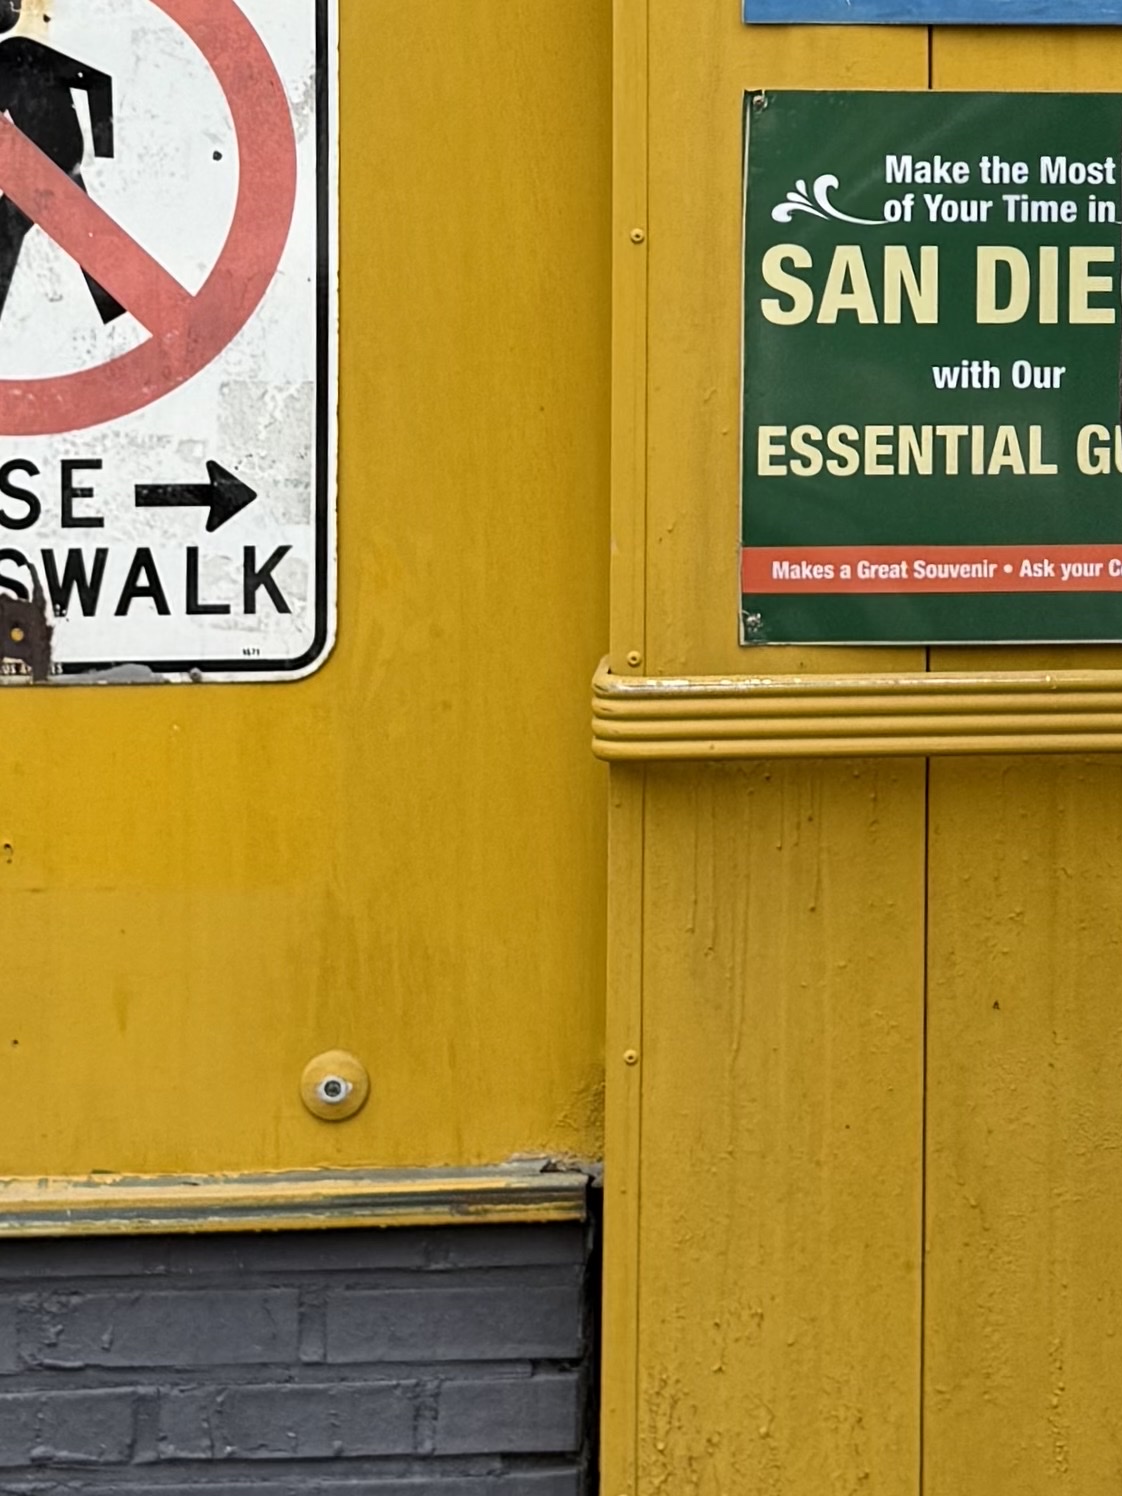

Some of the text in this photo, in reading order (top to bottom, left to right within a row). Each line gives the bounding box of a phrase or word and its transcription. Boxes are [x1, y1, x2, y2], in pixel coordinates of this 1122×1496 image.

[885, 155, 1116, 185] Make the Most
[883, 193, 1116, 223] of Your Time in
[761, 243, 1116, 326] SAN DIE
[932, 359, 1066, 389] with Our
[757, 424, 1058, 476] ESSENTIAL
[0, 458, 105, 530] SE
[772, 560, 835, 580] Makes
[840, 564, 851, 579] a
[857, 560, 908, 580] Great
[913, 559, 998, 579] Souvenir
[1019, 558, 1055, 578] Ask
[1061, 560, 1104, 581] your
